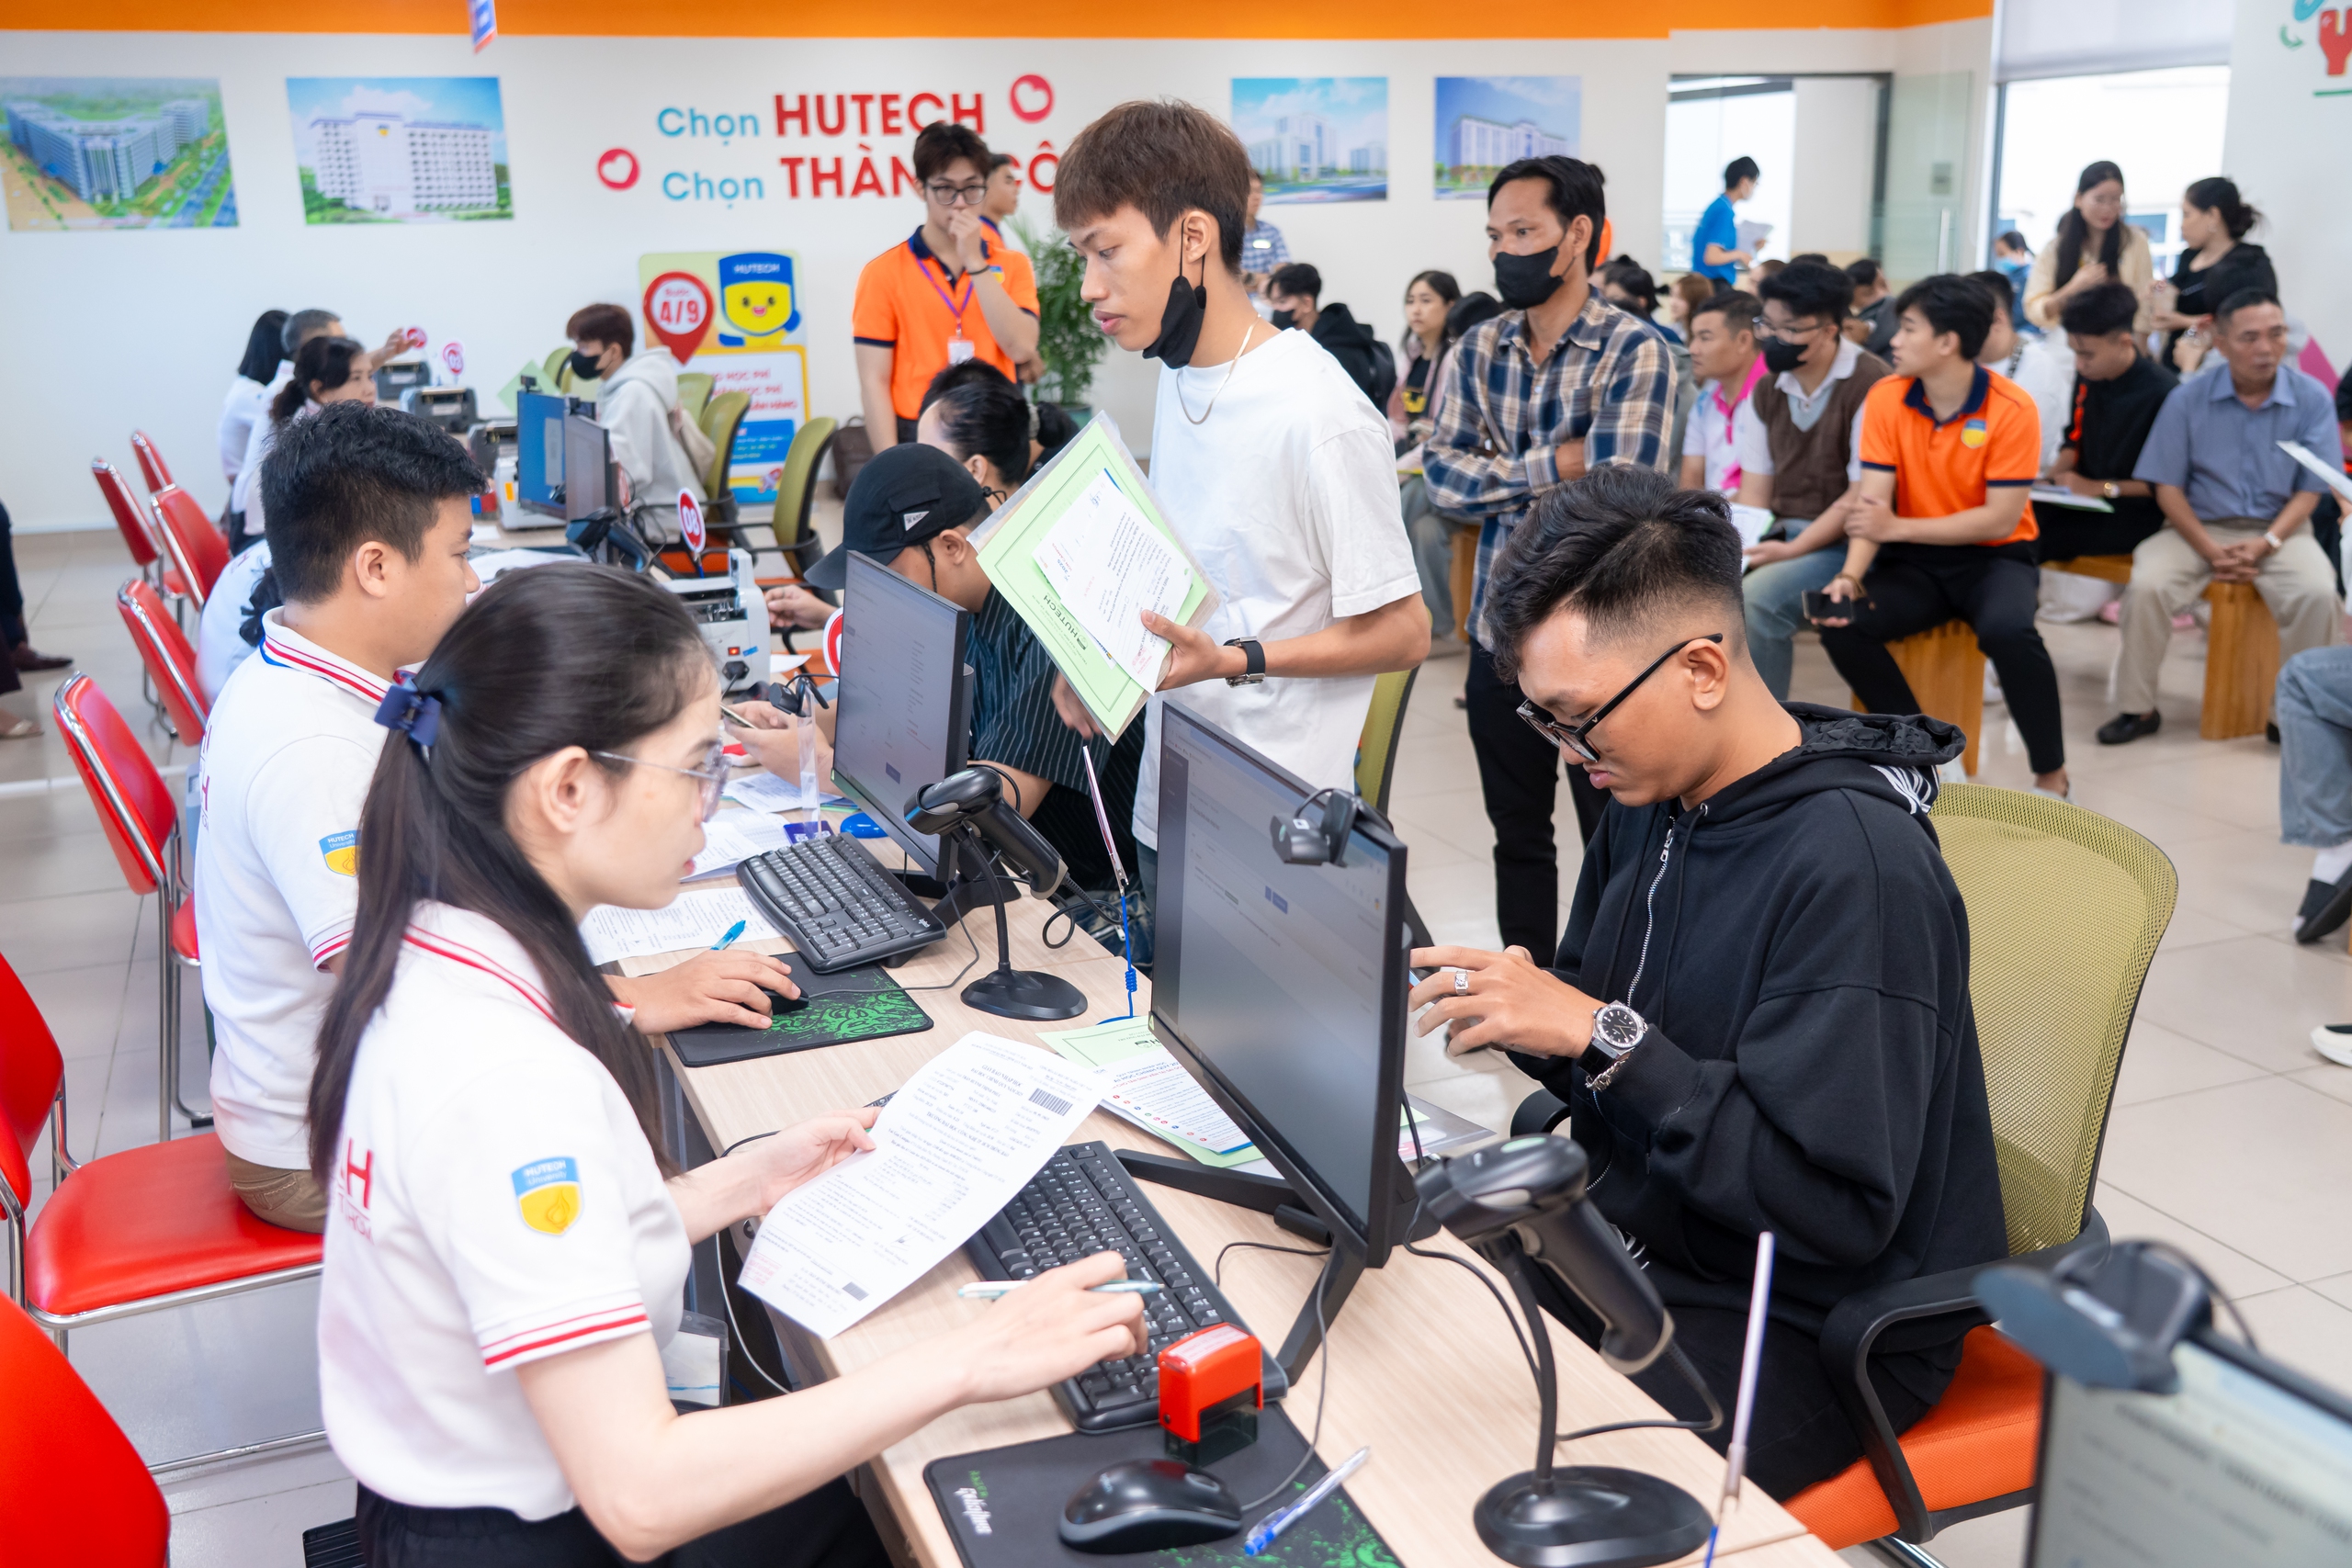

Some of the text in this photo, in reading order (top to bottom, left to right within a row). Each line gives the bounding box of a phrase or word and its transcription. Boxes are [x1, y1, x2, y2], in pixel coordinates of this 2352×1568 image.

[657, 93, 985, 145] Chọn HUTECH
[662, 171, 764, 209] Chọn
[780, 143, 914, 199] THÀN
[660, 299, 700, 325] 4/9
[682, 505, 700, 536] 08
[1042, 592, 1079, 638] HUTECH
[327, 832, 355, 844] HUTECH
[329, 840, 356, 849] University
[523, 1159, 567, 1177] HUTECH
[526, 1170, 568, 1187] University
